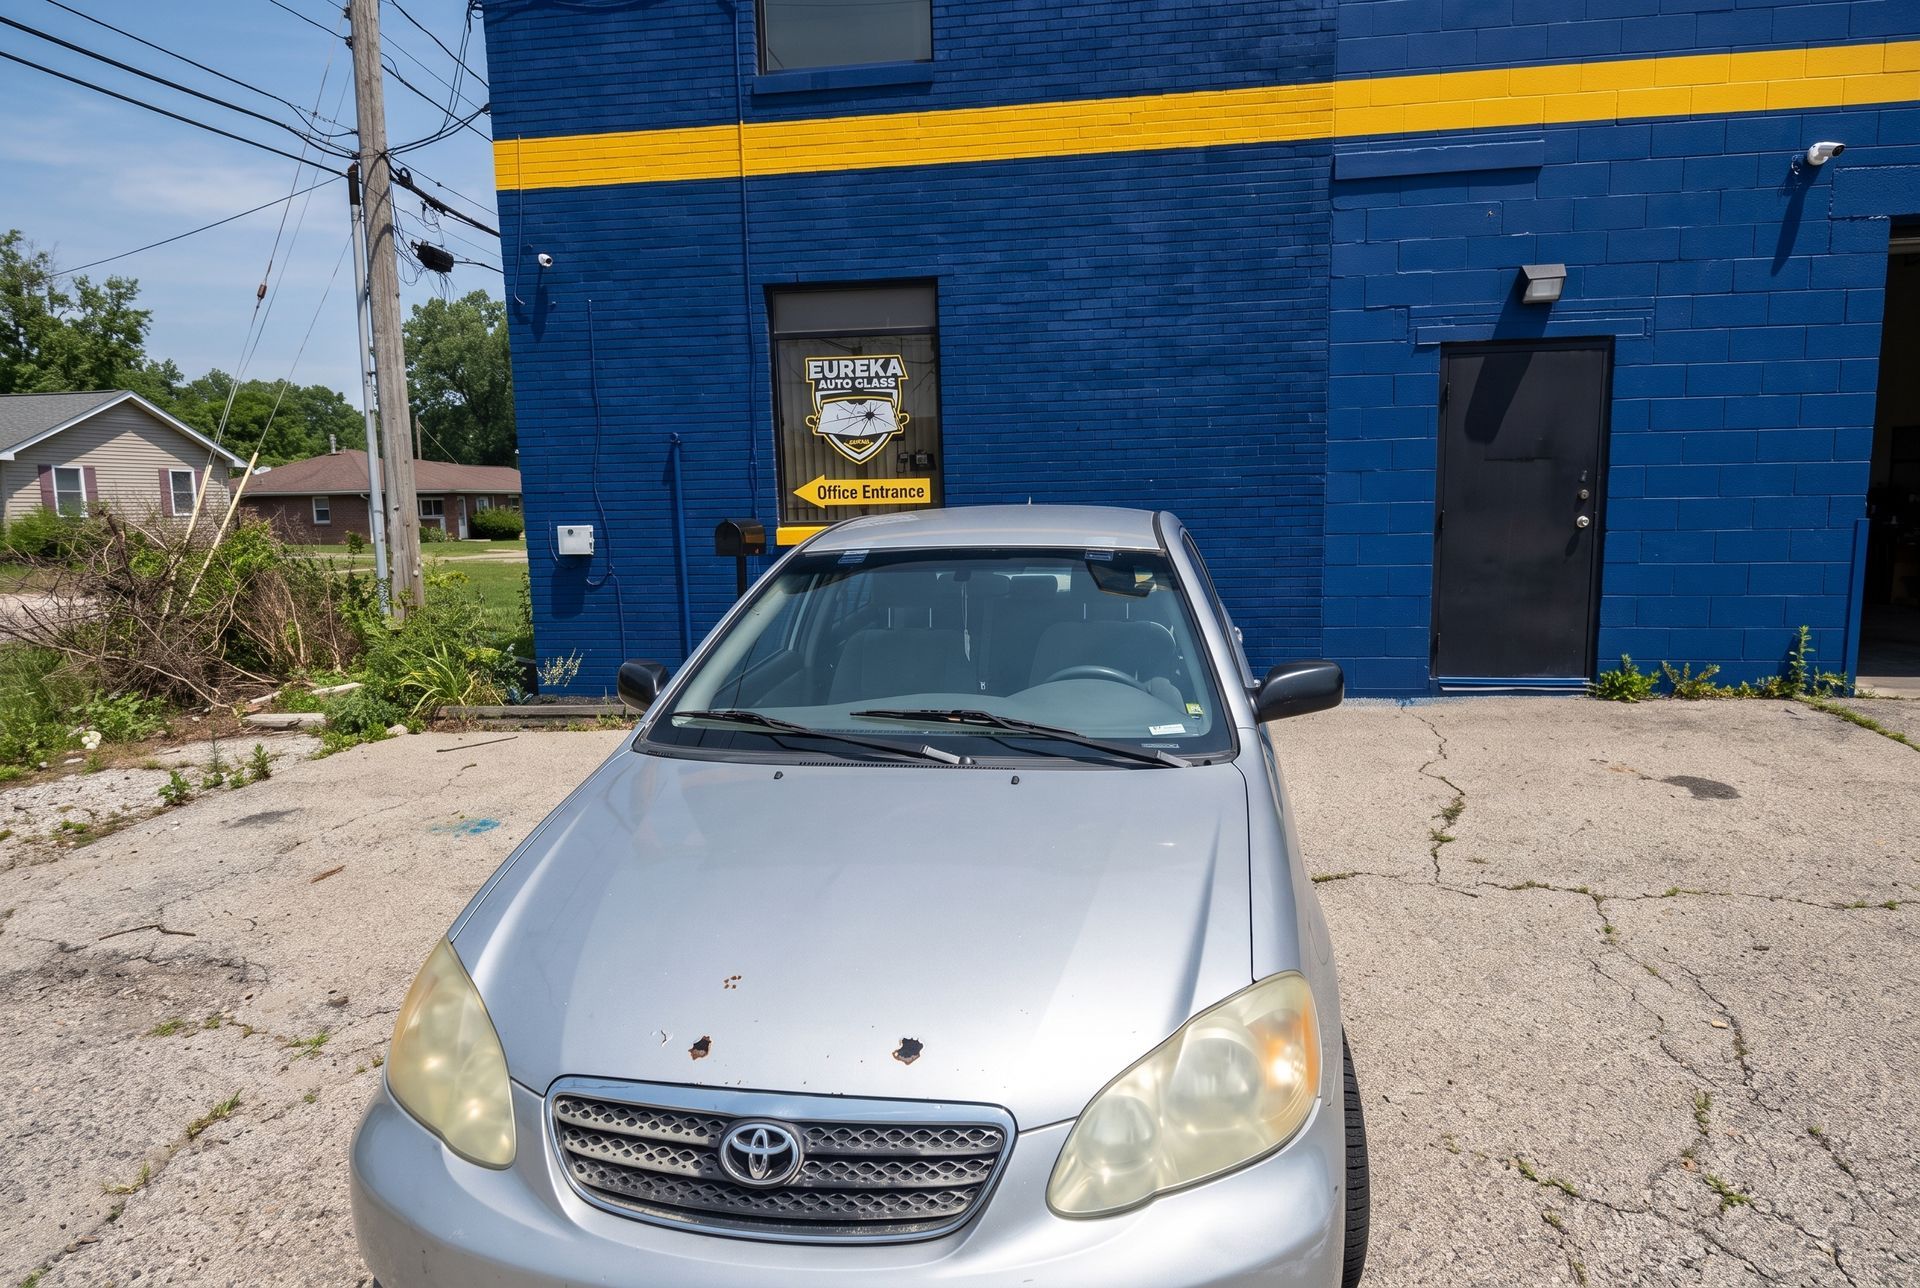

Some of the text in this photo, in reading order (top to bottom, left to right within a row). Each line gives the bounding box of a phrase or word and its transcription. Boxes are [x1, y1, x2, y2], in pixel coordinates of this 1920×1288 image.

[808, 358, 904, 379] EUREKA
[818, 378, 896, 389] AUTO GLASS
[817, 485, 925, 500] Office Entrance
